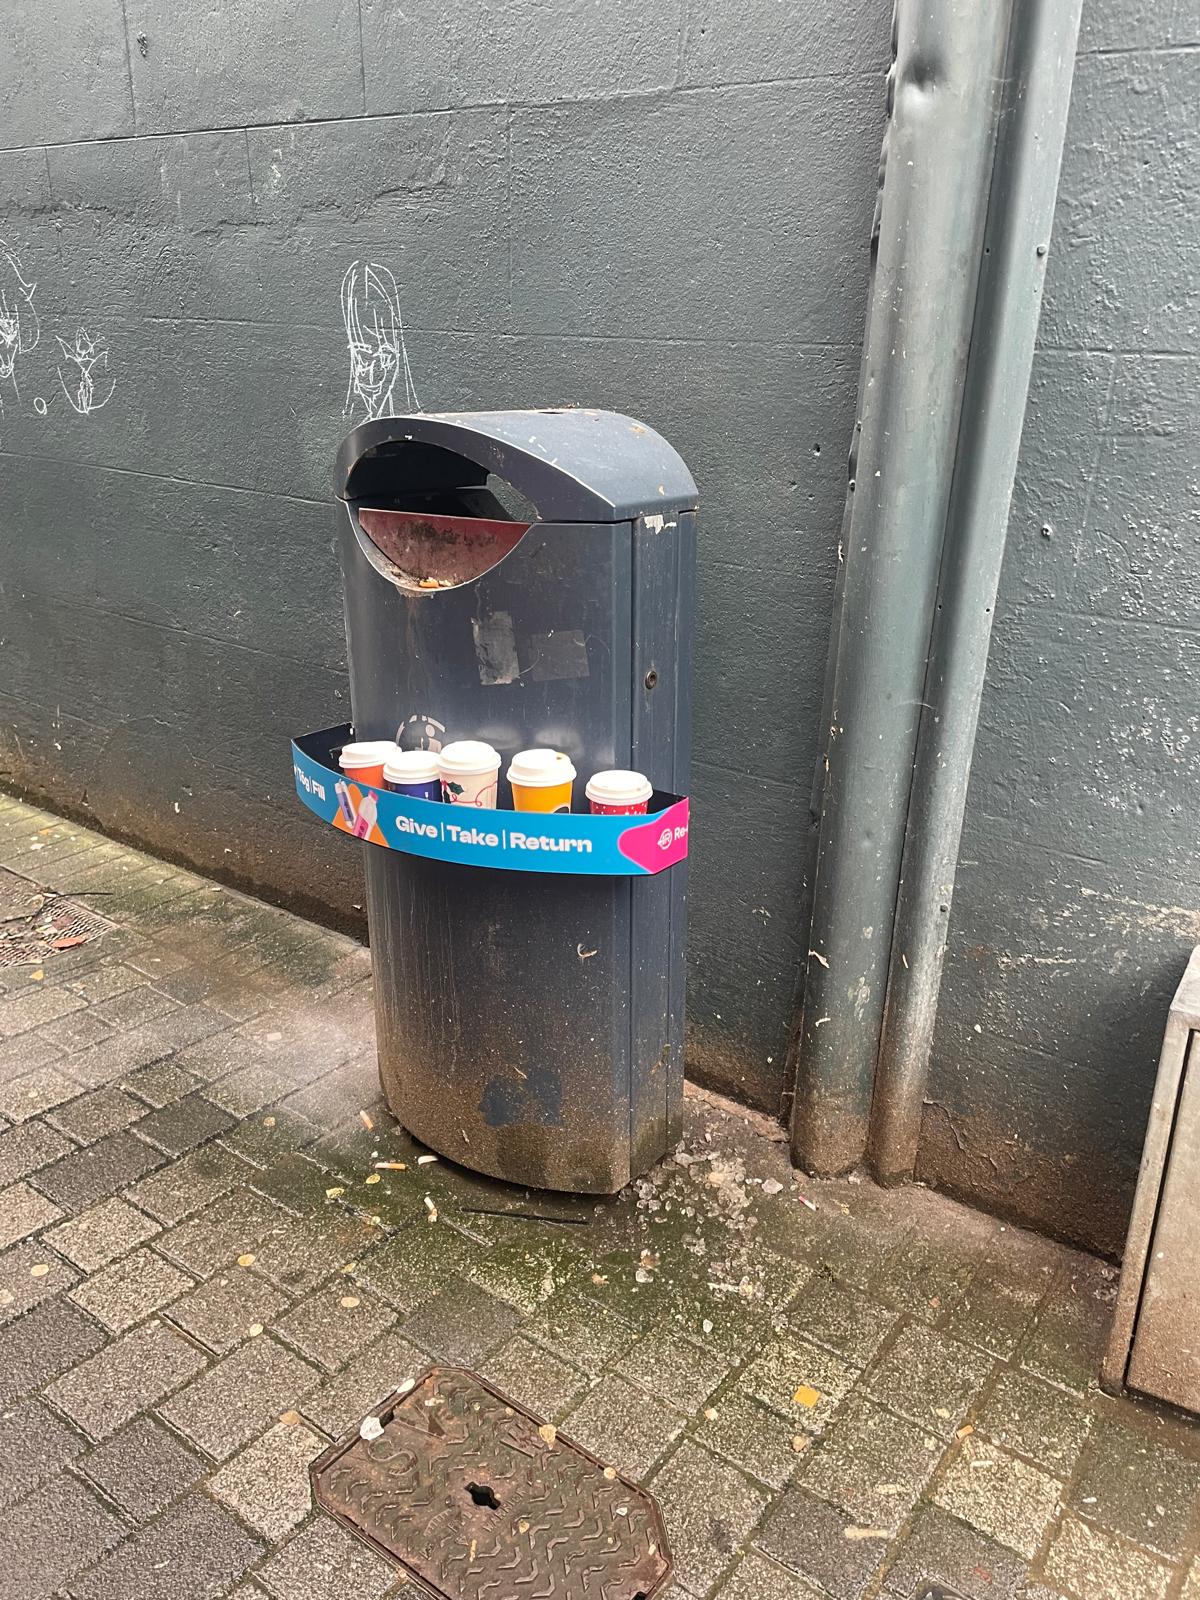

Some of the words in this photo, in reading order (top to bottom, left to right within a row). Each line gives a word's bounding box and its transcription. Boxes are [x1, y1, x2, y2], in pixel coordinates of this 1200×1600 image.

[312, 779, 326, 802] Fill
[395, 815, 438, 838] Give
[446, 824, 499, 847] Take
[510, 832, 593, 853] Return
[674, 823, 689, 841] Re-
